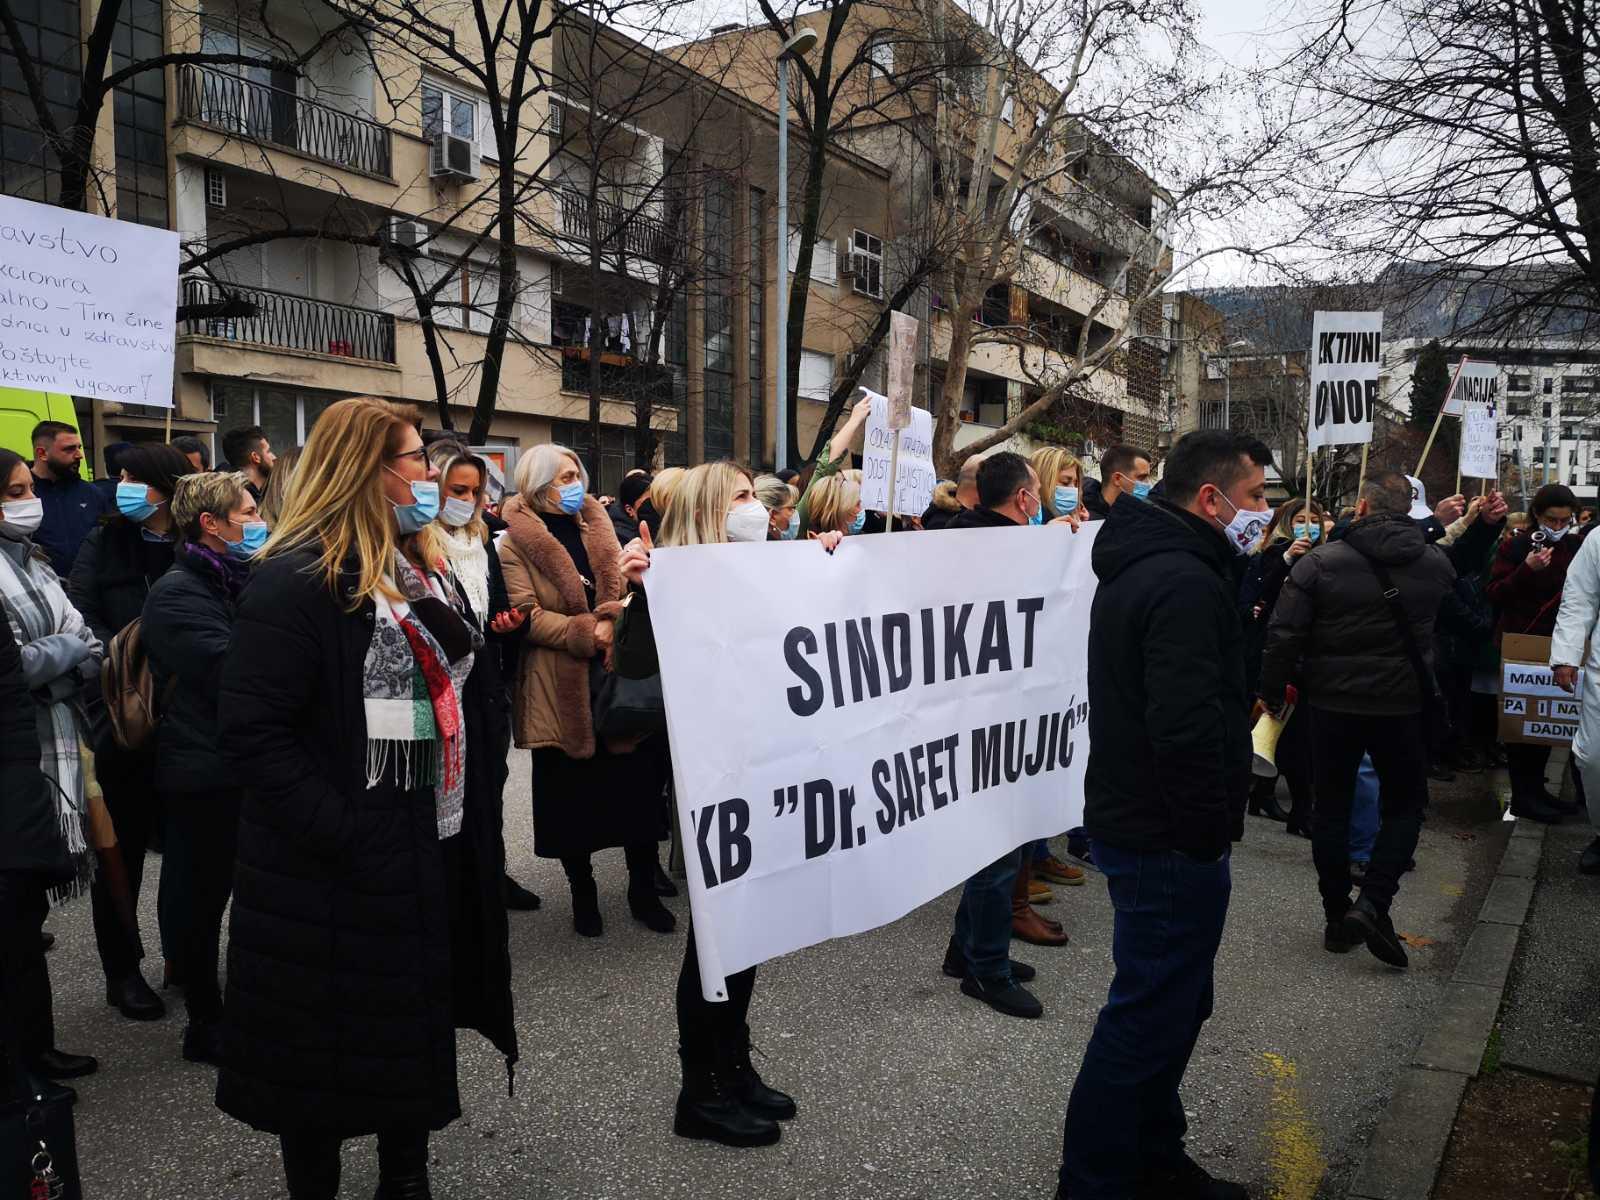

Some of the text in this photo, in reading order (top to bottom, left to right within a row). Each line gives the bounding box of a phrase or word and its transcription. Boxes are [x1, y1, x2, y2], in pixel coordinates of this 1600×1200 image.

[74, 302, 115, 323] Tim
[783, 597, 1045, 717] SINDIKAT
[1504, 699, 1523, 712] PA
[871, 732, 960, 836] SAFET
